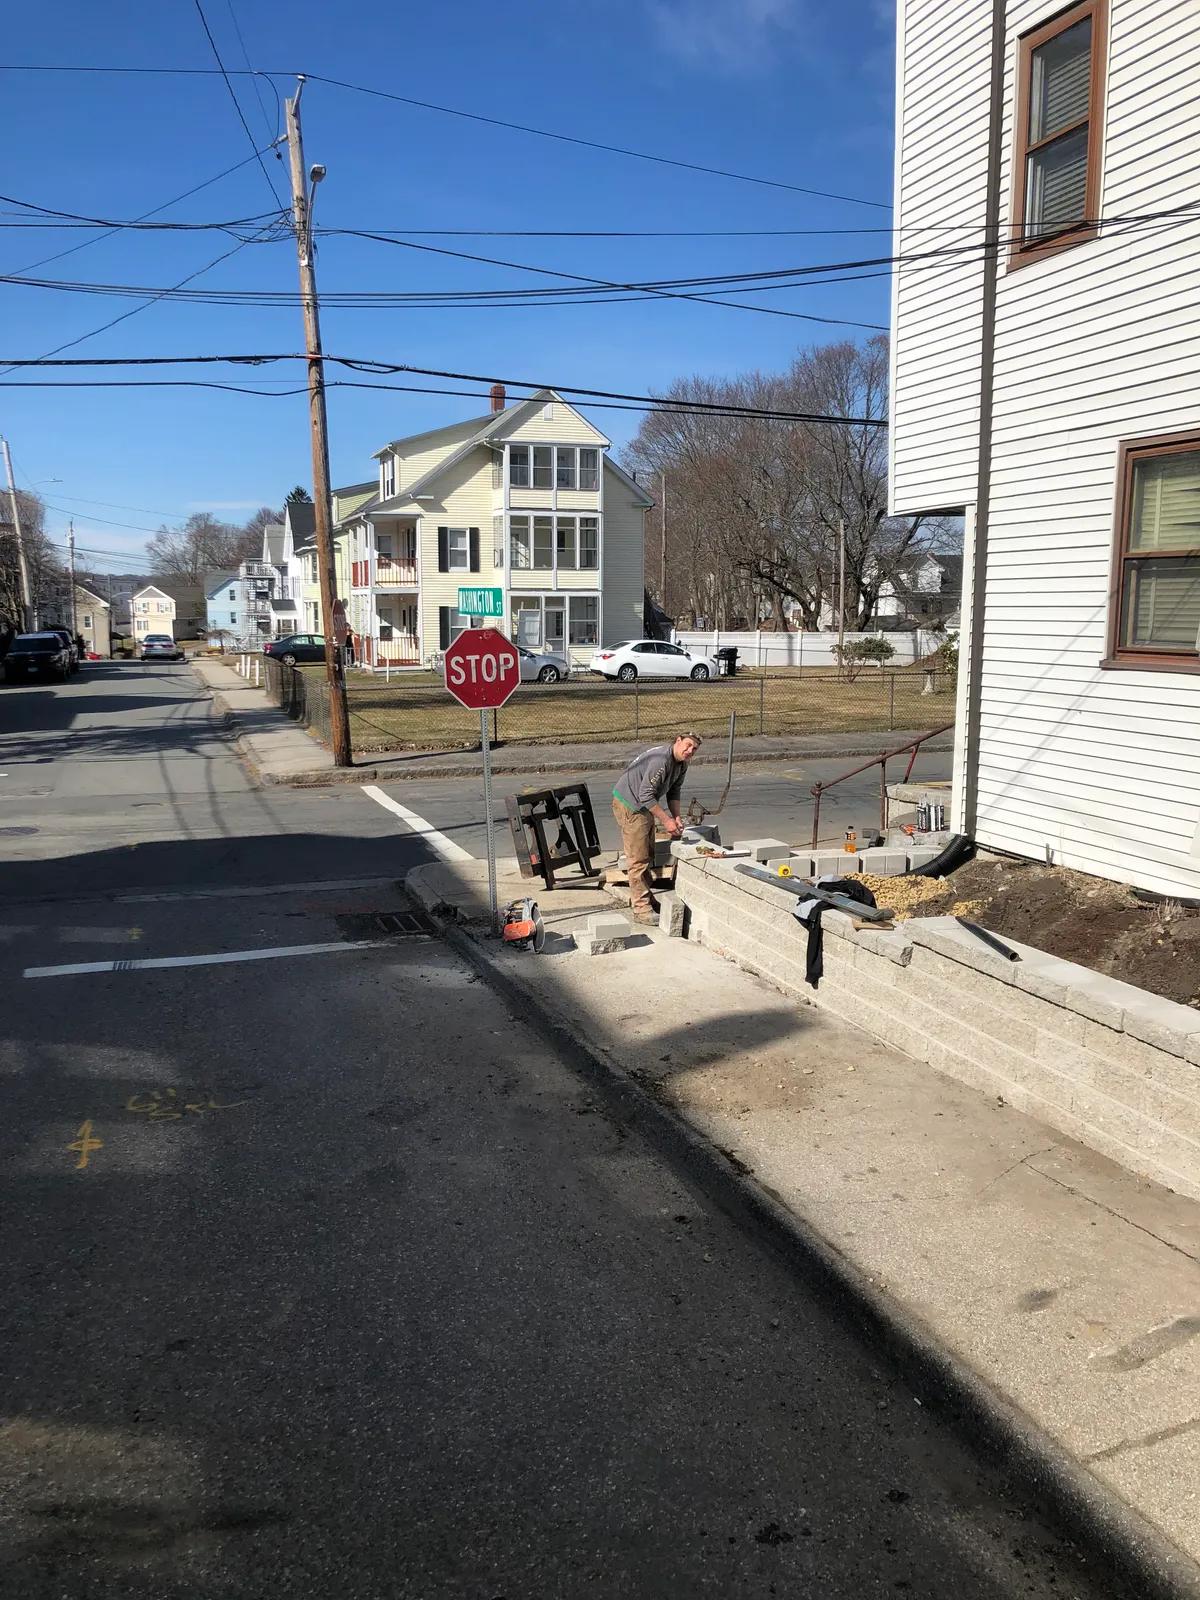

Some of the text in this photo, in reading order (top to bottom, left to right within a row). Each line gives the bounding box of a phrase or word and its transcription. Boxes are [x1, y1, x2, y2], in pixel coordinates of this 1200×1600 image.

[458, 590, 502, 614] WASHINGTON ST
[450, 653, 515, 685] STOP
